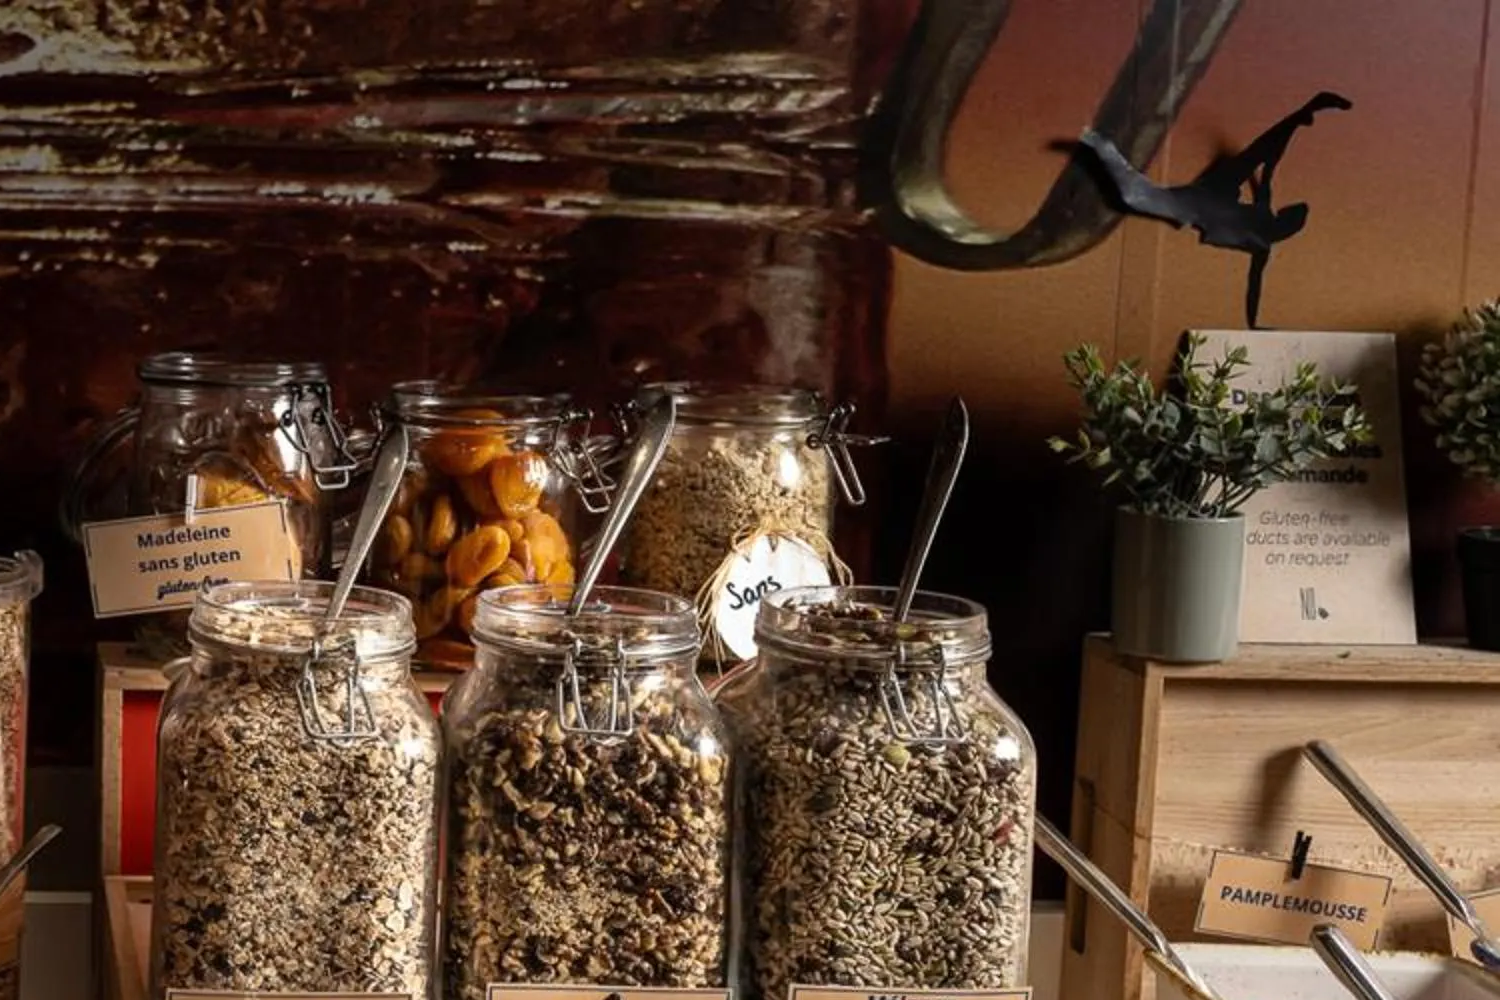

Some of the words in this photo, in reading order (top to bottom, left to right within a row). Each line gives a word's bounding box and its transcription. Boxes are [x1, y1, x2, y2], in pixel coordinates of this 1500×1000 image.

[137, 525, 231, 549] Madeleine
[1246, 530, 1290, 546] ducts
[1293, 533, 1319, 546] are
[1323, 530, 1391, 547] available
[138, 556, 179, 573] sans
[183, 550, 241, 572] gluten
[1264, 552, 1285, 566] on
[1287, 551, 1350, 568] request
[725, 575, 783, 611] Sans
[1220, 884, 1368, 923] PAMPLEMOUSSE
